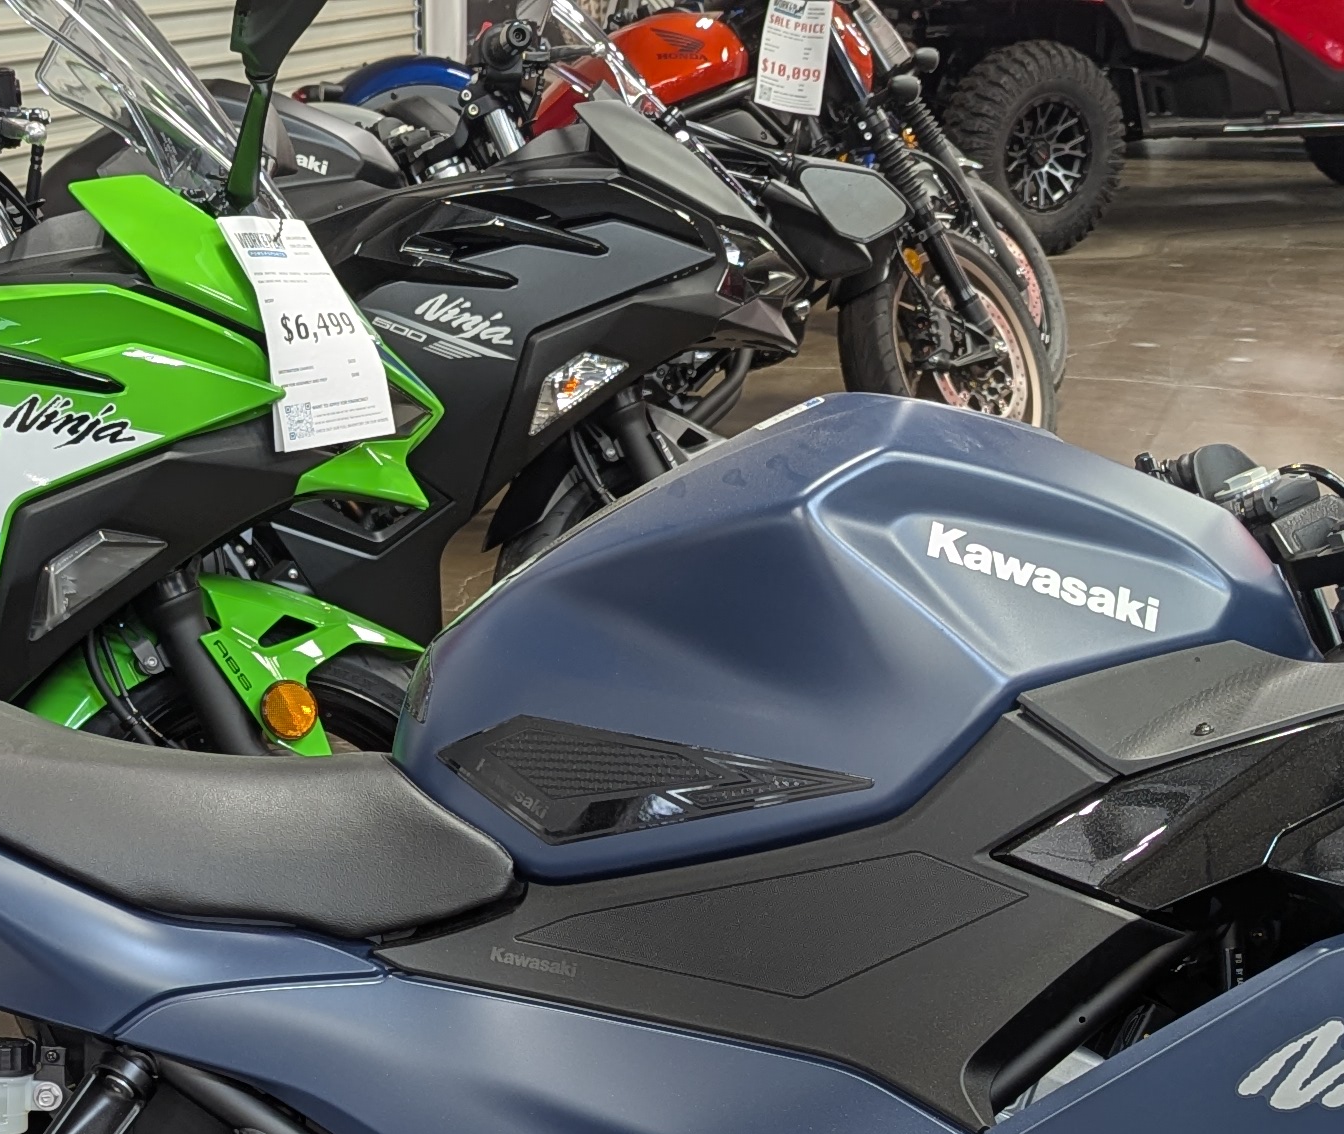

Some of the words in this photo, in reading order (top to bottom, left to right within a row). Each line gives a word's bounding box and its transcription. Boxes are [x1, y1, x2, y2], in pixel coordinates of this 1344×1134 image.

[769, 14, 789, 28] SALE
[794, 22, 826, 34] PRICE
[656, 53, 709, 61] HONDA
[761, 57, 821, 82] $10,099
[280, 312, 356, 344] $6,499
[372, 316, 427, 342] 500
[414, 293, 513, 345] Ninja
[2, 396, 136, 450] Ninja
[927, 521, 1160, 632] Kawasaki
[213, 639, 253, 691] ABS
[490, 946, 578, 977] Kawasaki
